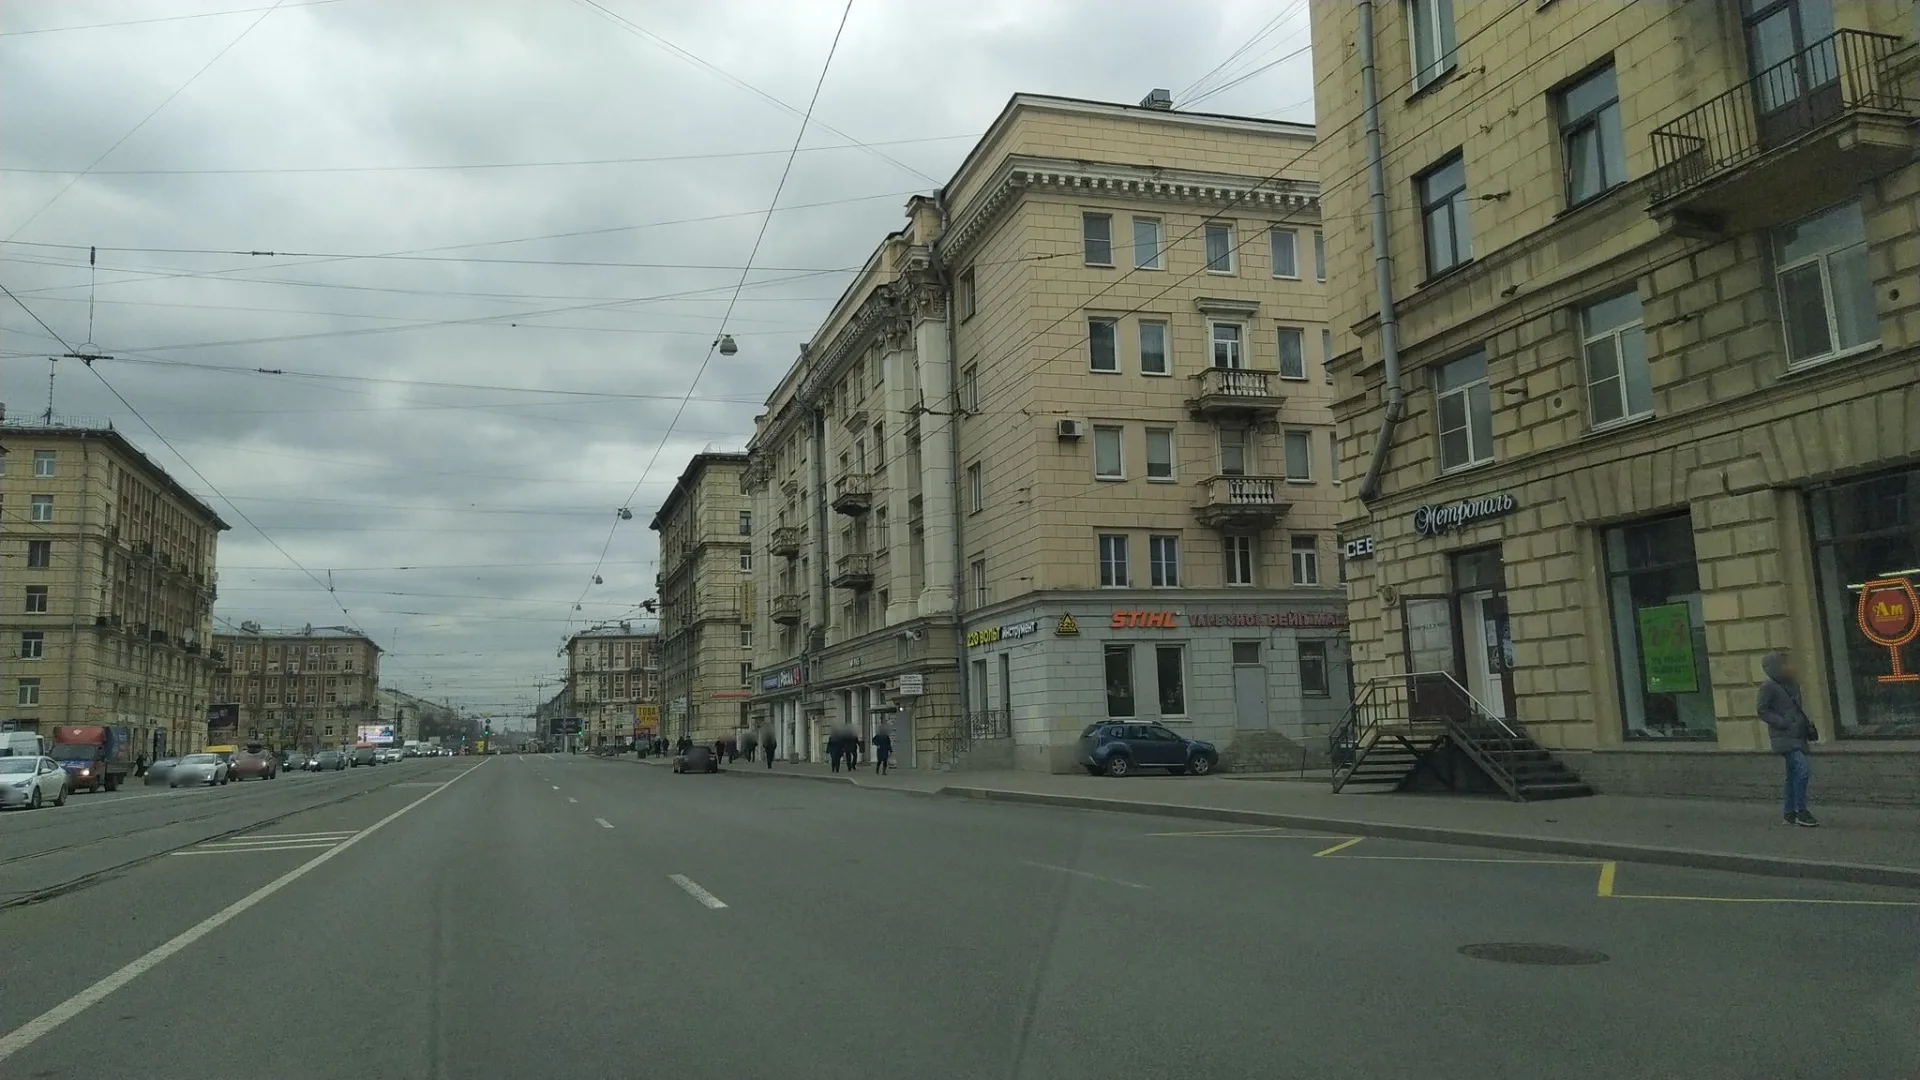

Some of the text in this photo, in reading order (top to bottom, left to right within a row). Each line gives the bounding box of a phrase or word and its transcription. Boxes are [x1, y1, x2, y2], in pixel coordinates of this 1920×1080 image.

[1413, 494, 1513, 535] Метрополь
[1110, 611, 1177, 629] STIHL
[1189, 613, 1223, 627] VAPE
